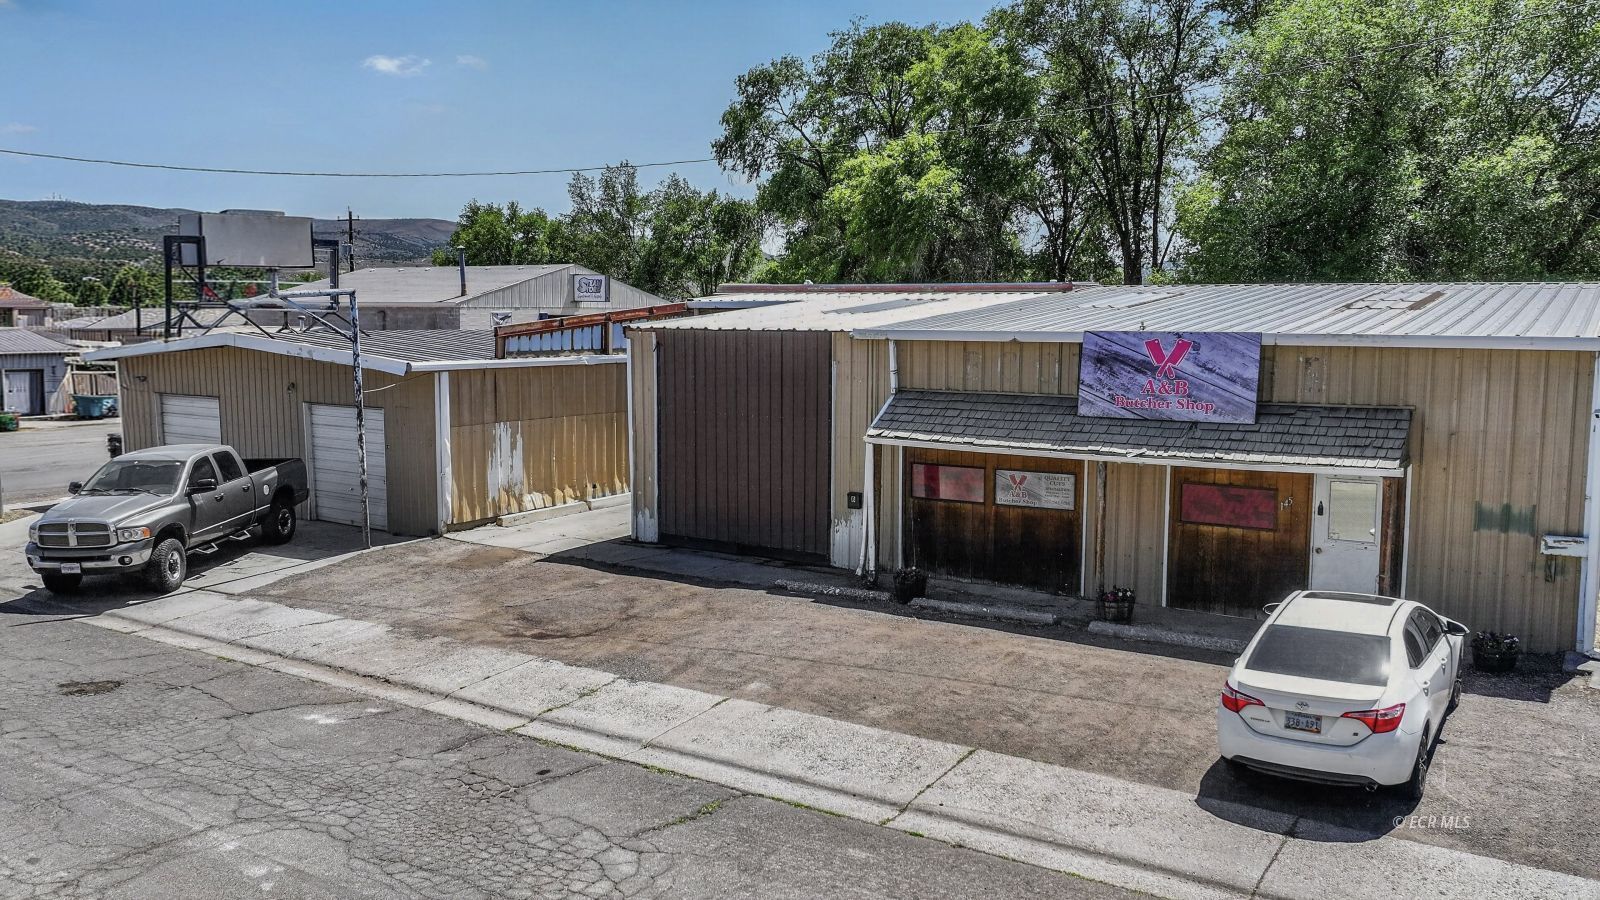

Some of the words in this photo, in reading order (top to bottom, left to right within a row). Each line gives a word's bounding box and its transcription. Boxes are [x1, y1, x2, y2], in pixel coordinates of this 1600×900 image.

[1141, 379, 1189, 395] A&B
[1114, 396, 1172, 410] Butcher
[1176, 398, 1215, 415] Shop
[1023, 499, 1038, 507] Shop
